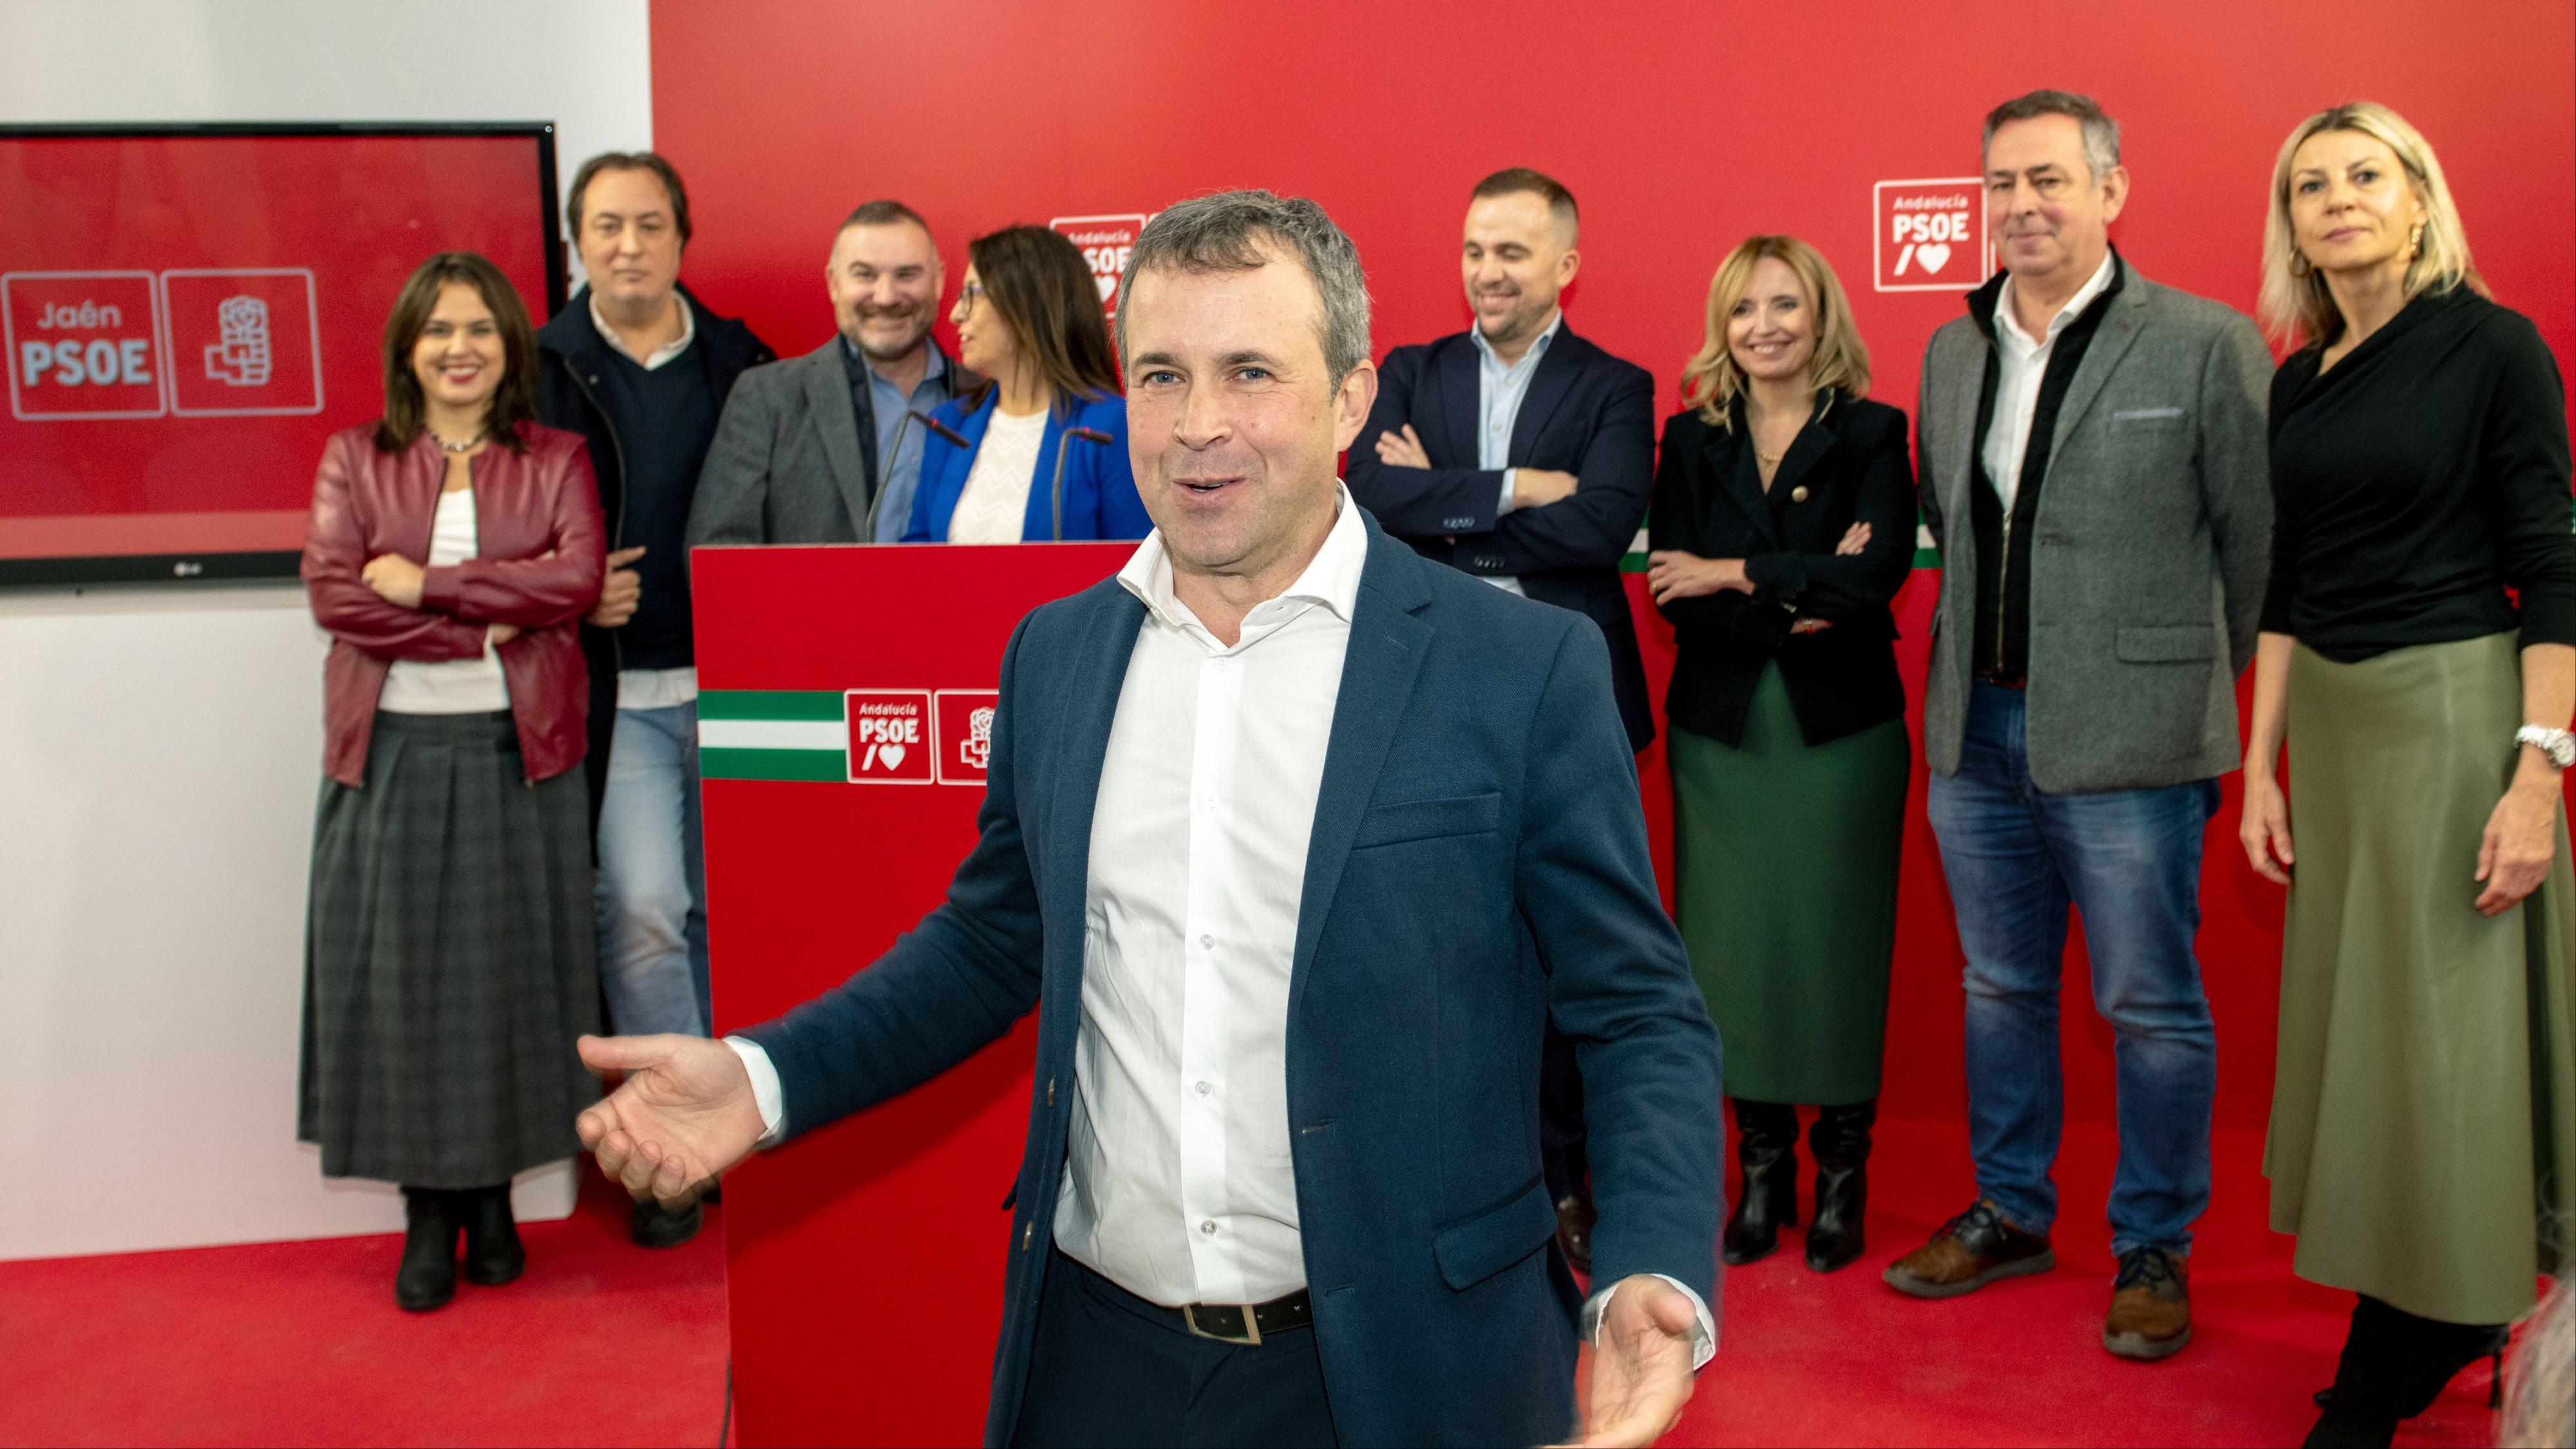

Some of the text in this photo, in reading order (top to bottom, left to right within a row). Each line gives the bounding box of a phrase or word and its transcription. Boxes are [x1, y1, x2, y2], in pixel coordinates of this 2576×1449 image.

[1893, 194, 1969, 210] Andalucía
[1892, 212, 1970, 243] PSOE
[1083, 246, 1132, 274] SOE
[37, 299, 122, 328] Jaén
[21, 339, 152, 386] PSOE
[859, 701, 918, 715] Andalucía
[859, 717, 920, 744] PSOE
